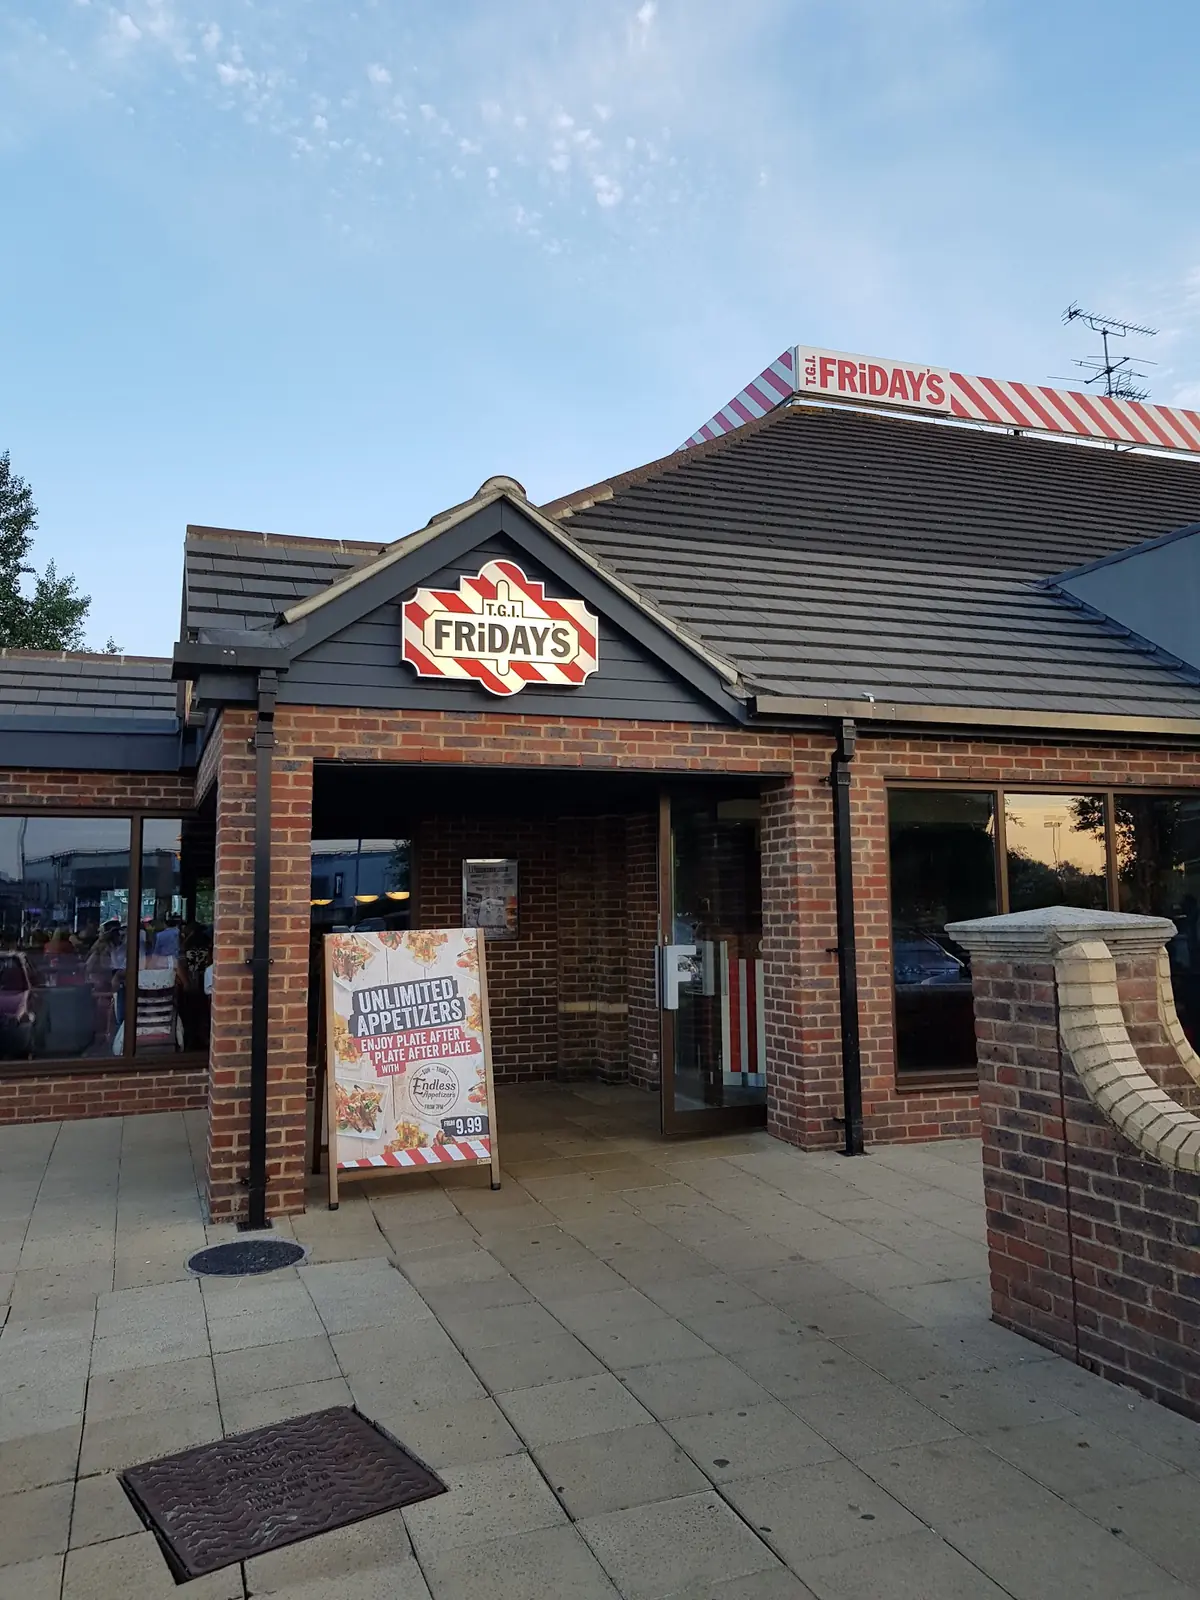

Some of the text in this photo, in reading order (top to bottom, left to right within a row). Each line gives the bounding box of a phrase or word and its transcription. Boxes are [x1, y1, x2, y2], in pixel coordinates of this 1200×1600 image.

[805, 355, 817, 386] T.G.I.
[486, 603, 520, 618] T.G.I.
[358, 978, 454, 1014] UNLIMITED
[357, 999, 463, 1037] APPETIZERS
[361, 1029, 460, 1052] ENJOY PLATE AFTER
[374, 1040, 472, 1065] PLATE AFTER PLATE
[381, 1063, 400, 1074] WITH
[413, 1077, 456, 1094] Endless
[422, 1091, 456, 1099] Appetizers
[456, 1117, 482, 1134] 9.99
